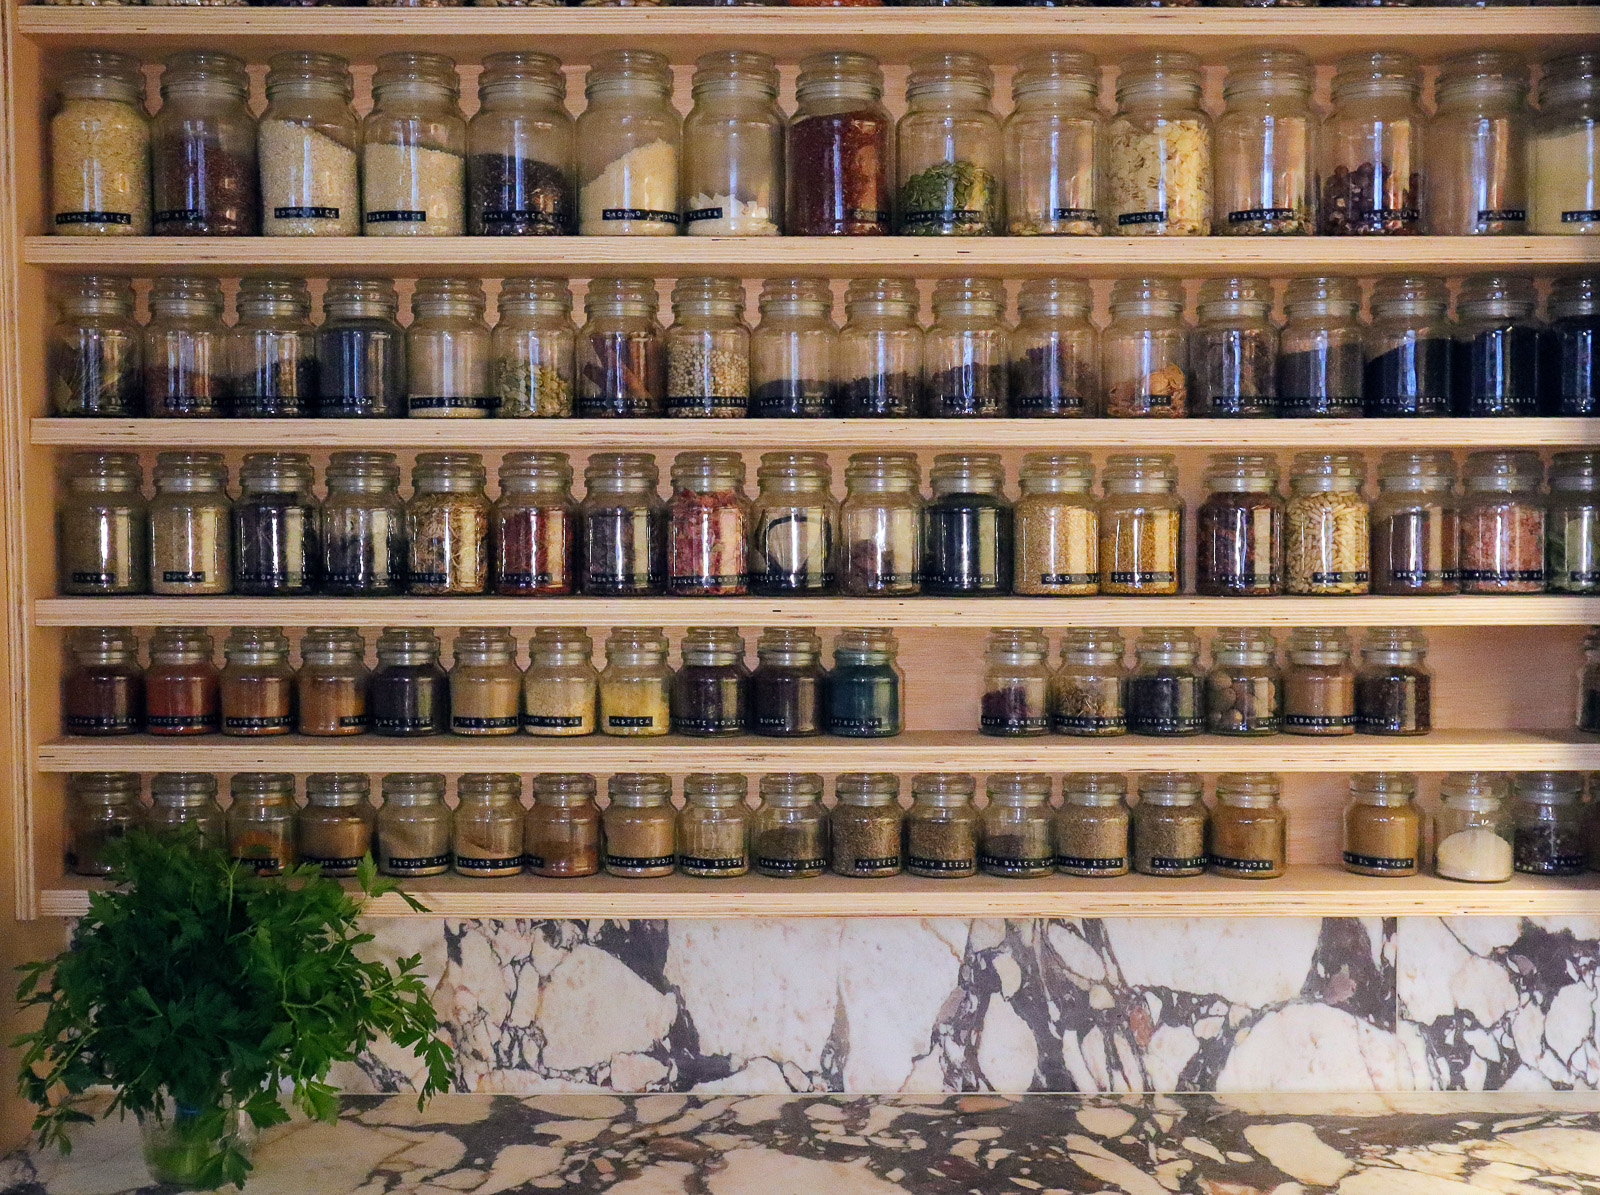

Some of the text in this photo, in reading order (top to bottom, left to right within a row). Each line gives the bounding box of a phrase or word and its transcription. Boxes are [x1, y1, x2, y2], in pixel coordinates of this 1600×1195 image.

[605, 210, 641, 218] GROUND
[1120, 213, 1160, 222] ALMONDS
[102, 214, 127, 223] RICE
[544, 718, 580, 726] MAHLAB
[760, 717, 785, 725] SUMAC
[1008, 718, 1047, 726] BERRIES
[1137, 718, 1177, 726] JUNIPER
[1288, 717, 1336, 726] LEBANESE
[321, 858, 360, 866] CORIAND
[392, 859, 427, 868] GROUND
[498, 858, 523, 867] GING
[645, 858, 673, 866] POWDER
[714, 859, 742, 867] SEEDS
[761, 858, 827, 868] CARAWAY SEEDS
[858, 858, 896, 867] ANISEED
[910, 858, 970, 869] CUMIN SEEDS
[1093, 859, 1120, 867] SEEDS
[1154, 857, 1207, 867] DILL SEEDS
[1233, 861, 1270, 869] POWDER
[1359, 857, 1369, 865] EL
[1376, 859, 1412, 867] HANOUT
